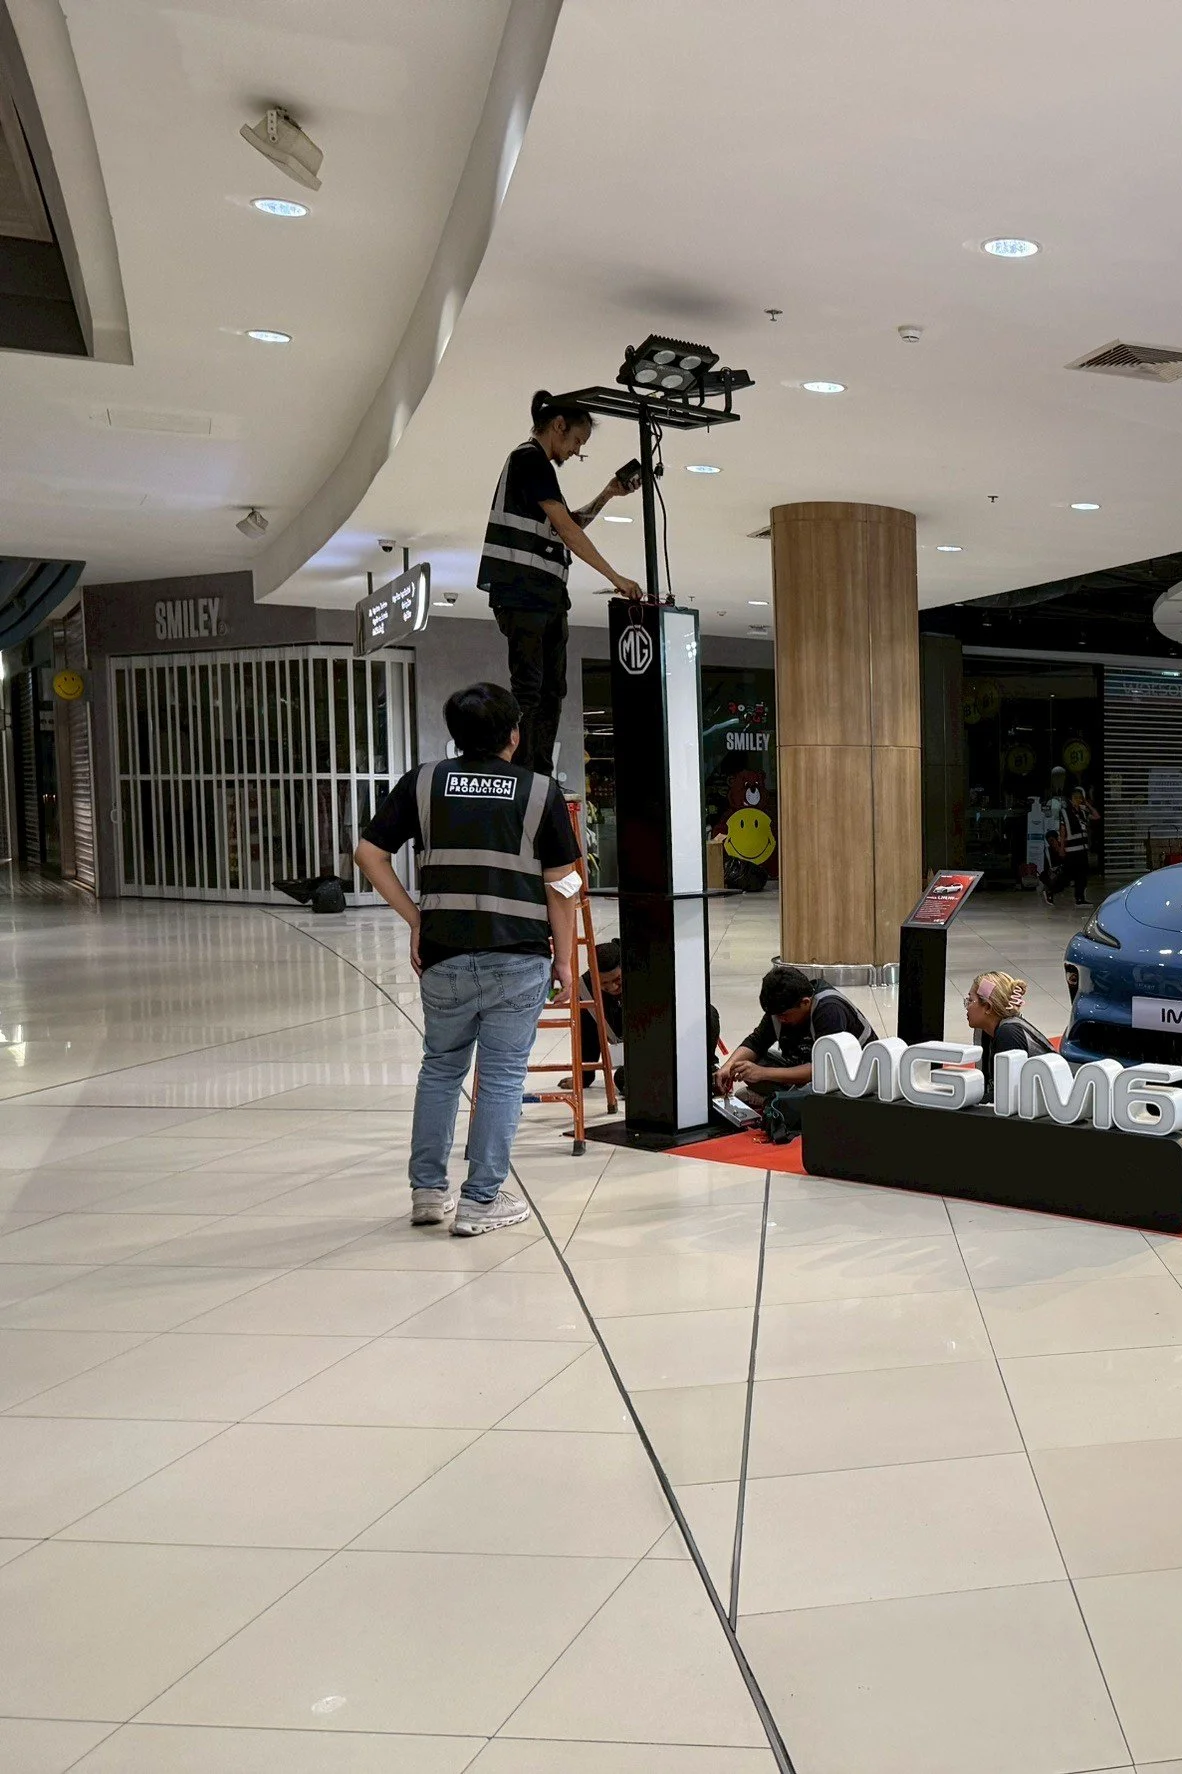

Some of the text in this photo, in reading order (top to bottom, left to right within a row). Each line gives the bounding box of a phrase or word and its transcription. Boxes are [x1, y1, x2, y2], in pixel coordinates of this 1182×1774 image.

[155, 597, 220, 640] SMILEY
[621, 629, 650, 670] MG
[726, 732, 770, 751] SMILEY
[449, 785, 511, 795] PRODUCTION
[450, 776, 512, 788] BRANCH
[811, 1031, 985, 1110] MG
